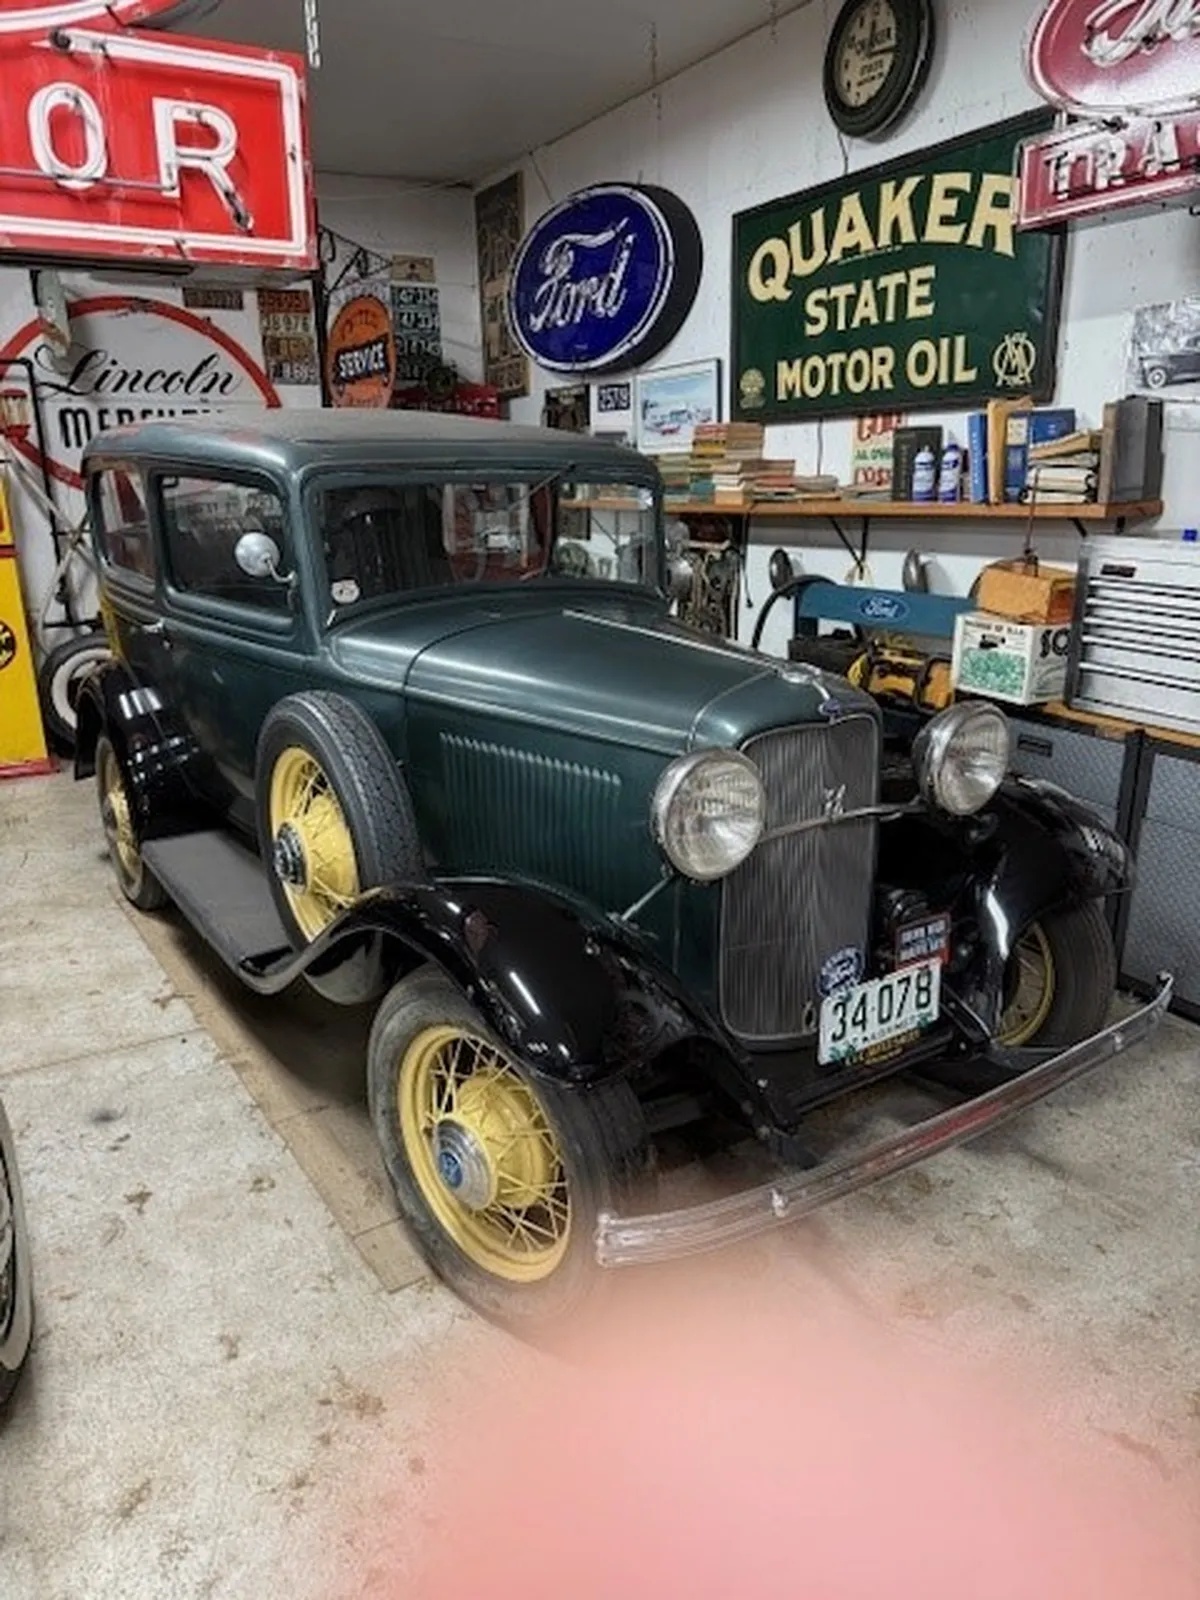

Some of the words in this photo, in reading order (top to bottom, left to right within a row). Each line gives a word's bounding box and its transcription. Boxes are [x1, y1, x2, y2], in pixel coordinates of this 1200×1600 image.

[1044, 120, 1200, 200] TRA
[748, 172, 1016, 302] QUAKER
[529, 217, 636, 333] Ford
[805, 265, 937, 336] STATE
[35, 344, 244, 397] Lincoln
[339, 342, 385, 379] SERVICE
[777, 347, 893, 401] MOTOR
[906, 335, 977, 388] OIL
[865, 597, 898, 618] Ford
